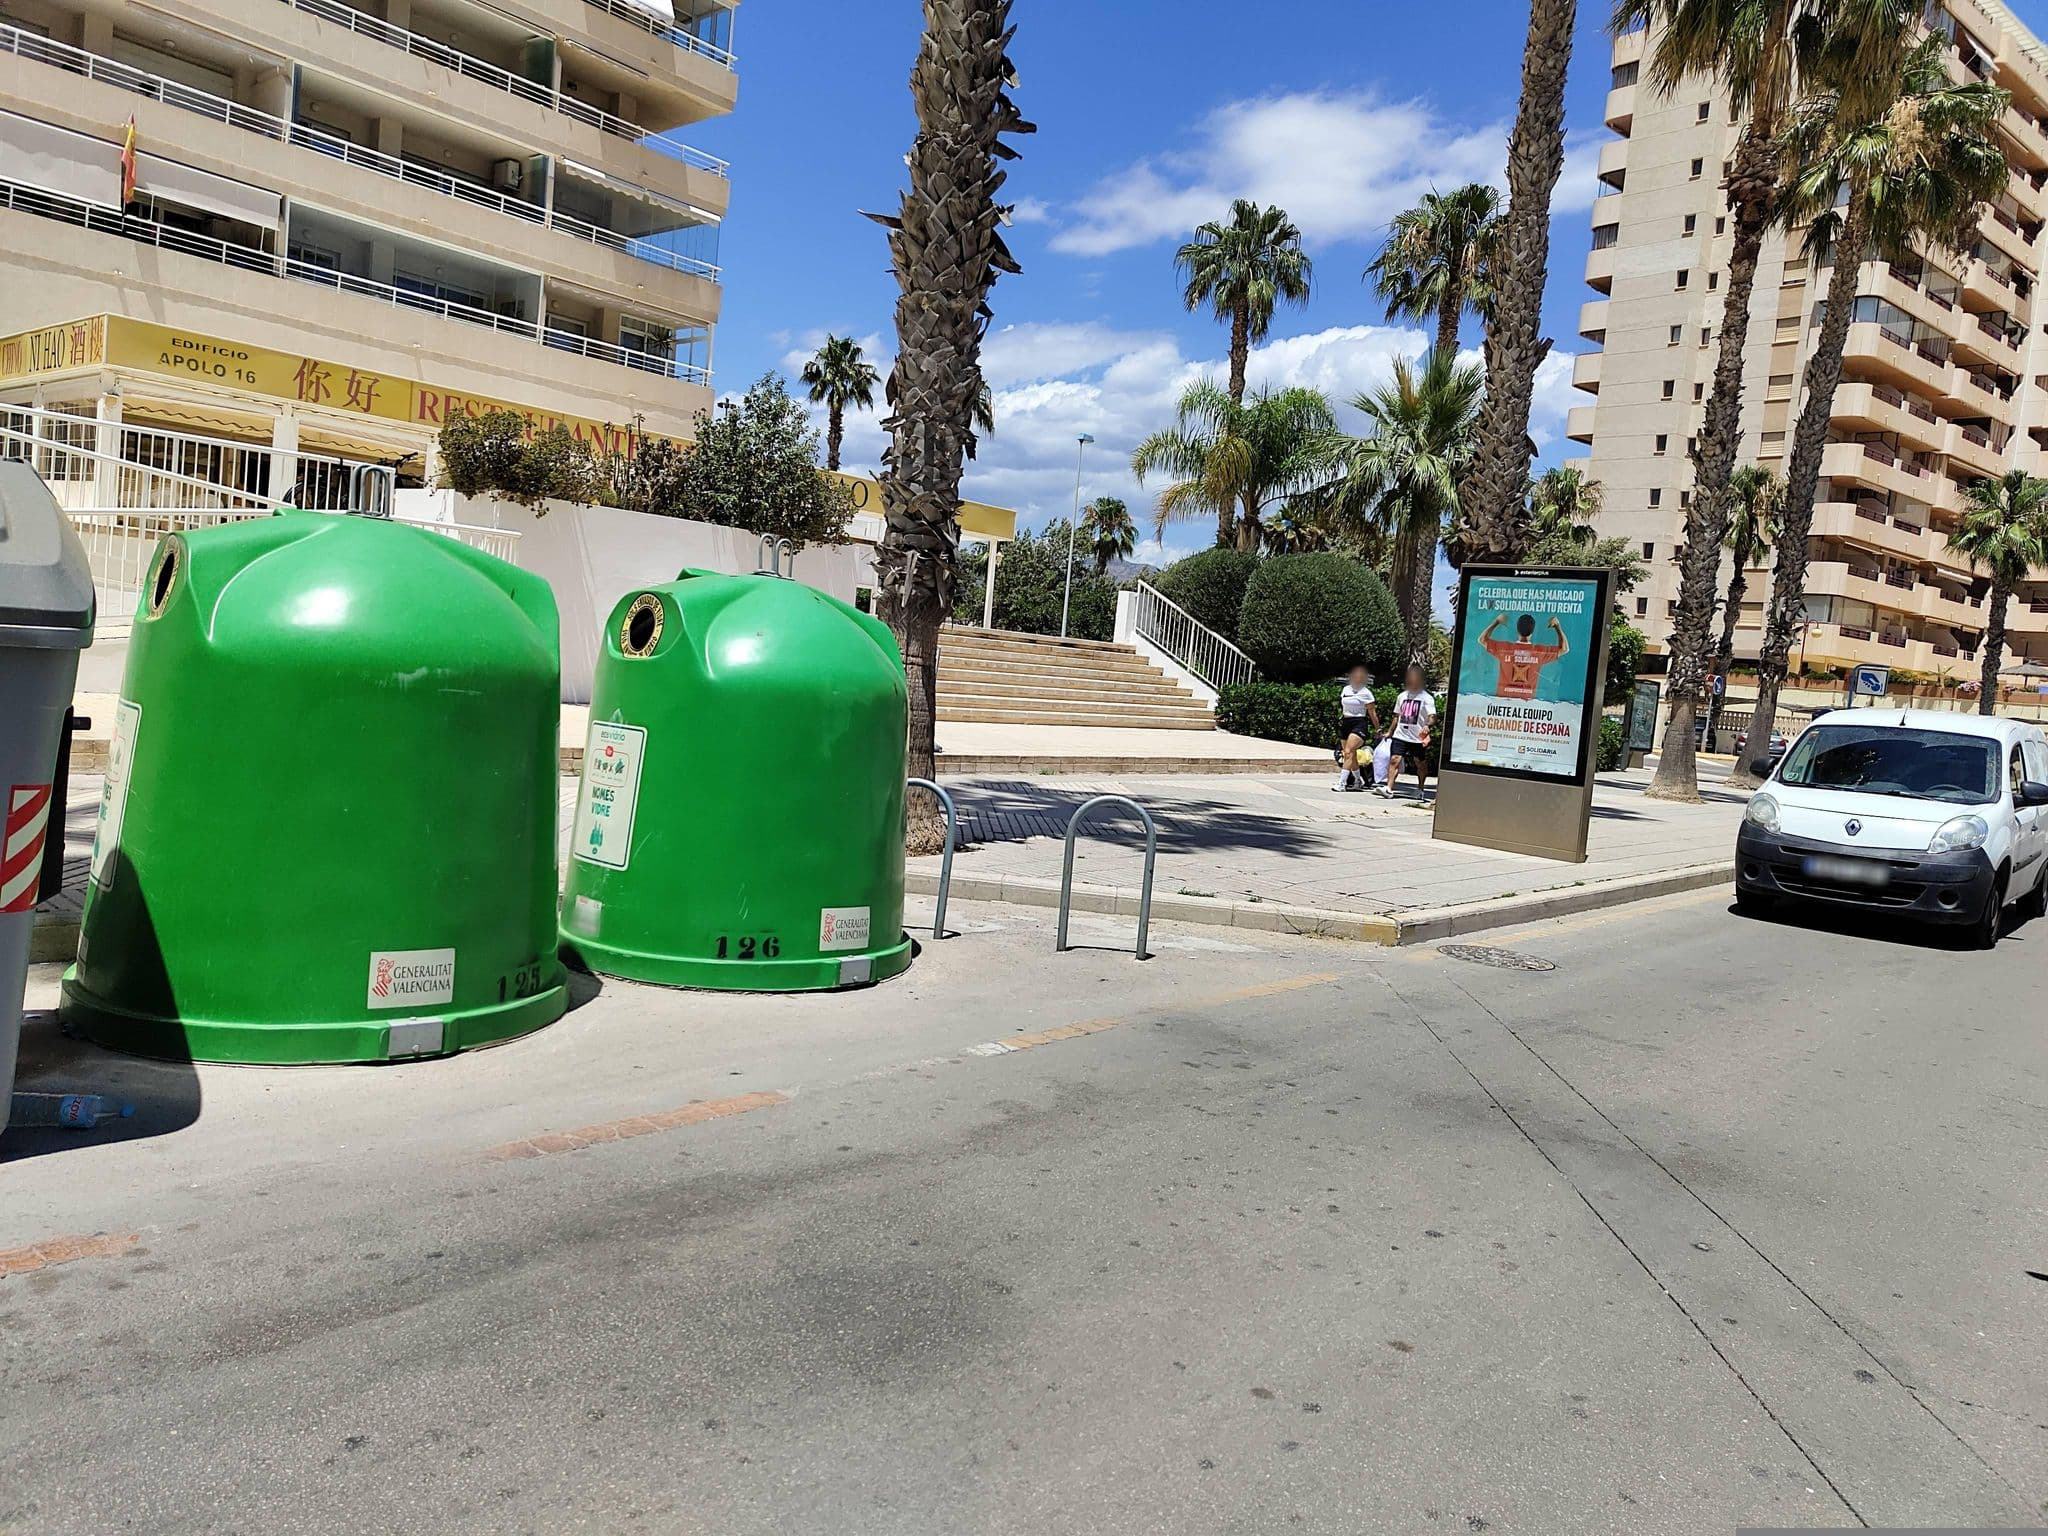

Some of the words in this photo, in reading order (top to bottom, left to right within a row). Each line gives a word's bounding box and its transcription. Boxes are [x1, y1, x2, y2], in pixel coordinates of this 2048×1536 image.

[29, 334, 41, 372] NI
[43, 328, 66, 369] HAO
[171, 337, 249, 360] EDIFICIO
[158, 352, 227, 378] APOLO
[234, 367, 257, 385] 16
[292, 358, 382, 413] 你好
[418, 389, 643, 461] RESTUANTE
[1478, 587, 1512, 599] CELEBRA
[1512, 588, 1528, 600] QUE
[1528, 589, 1545, 601] HAS
[1545, 590, 1585, 602] MARCADO
[1478, 599, 1488, 610] LA
[1494, 600, 1535, 612] SOLIDARIA
[1535, 602, 1545, 612] EN
[1546, 602, 1557, 613] TU
[1557, 602, 1582, 614] RENTA
[1487, 702, 1512, 717] ÚNETE
[1511, 707, 1522, 718] AL
[1523, 708, 1553, 721] EQUIPO
[1466, 714, 1487, 728] MÁS
[1487, 717, 1522, 732] GRANDE
[1523, 721, 1536, 734] DE
[1535, 722, 1571, 738] ESPAÑA
[1526, 746, 1557, 756] SOLIDARIA
[592, 785, 615, 802] NOMÉS
[591, 802, 611, 817] VIDRE
[835, 918, 869, 929] GENERALITAT
[835, 929, 868, 940] VALENCIANA
[715, 935, 781, 959] 126
[393, 963, 453, 979] GENERALITAT
[393, 979, 451, 994] VALENCIANA
[497, 965, 541, 1002] 125
